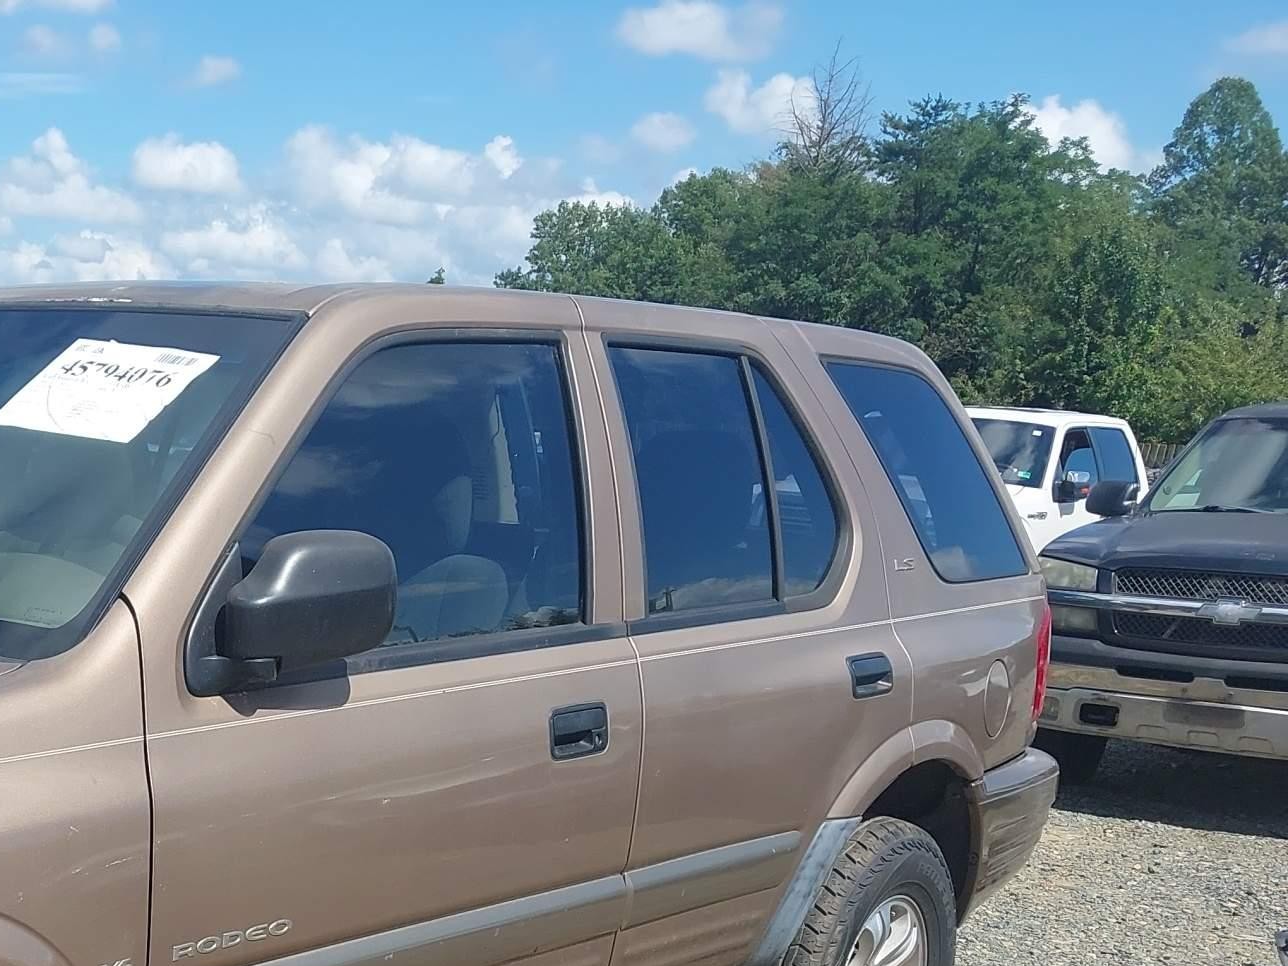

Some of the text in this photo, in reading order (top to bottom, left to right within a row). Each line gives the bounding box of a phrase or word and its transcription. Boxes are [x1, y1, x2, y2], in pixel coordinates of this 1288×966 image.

[60, 359, 178, 388] 45794076
[894, 557, 915, 572] LS
[171, 918, 293, 963] RODEO
